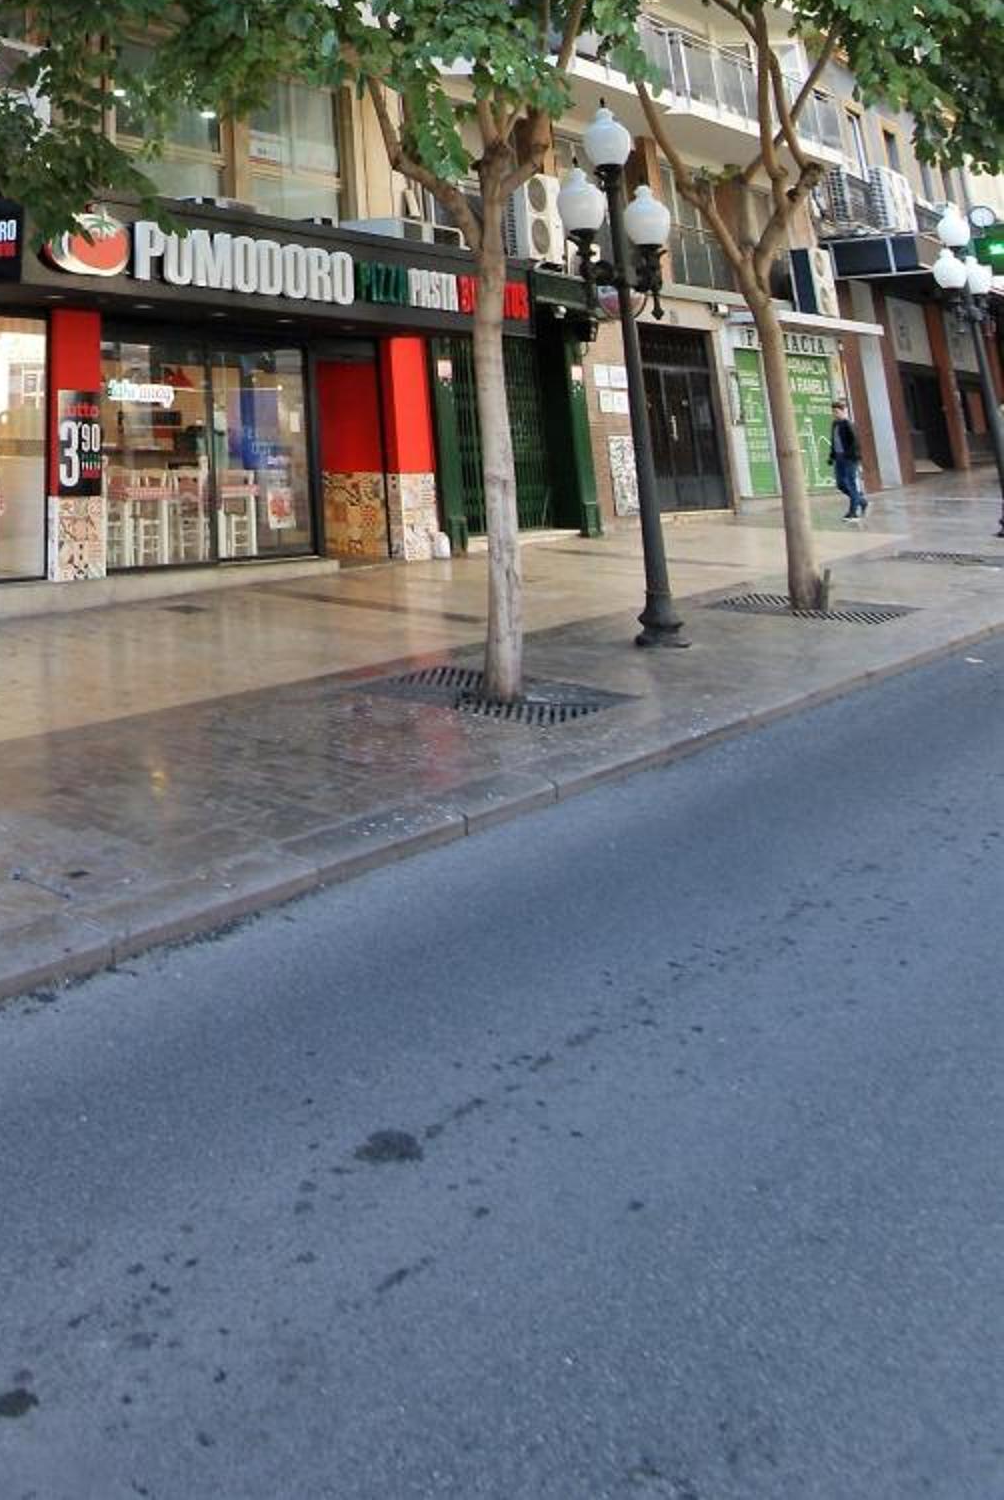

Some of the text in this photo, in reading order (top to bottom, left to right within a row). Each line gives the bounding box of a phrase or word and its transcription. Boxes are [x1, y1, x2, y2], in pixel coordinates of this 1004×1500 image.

[134, 220, 355, 306] POMODORO
[357, 260, 407, 304] PIZZA
[407, 268, 459, 312] PASTA
